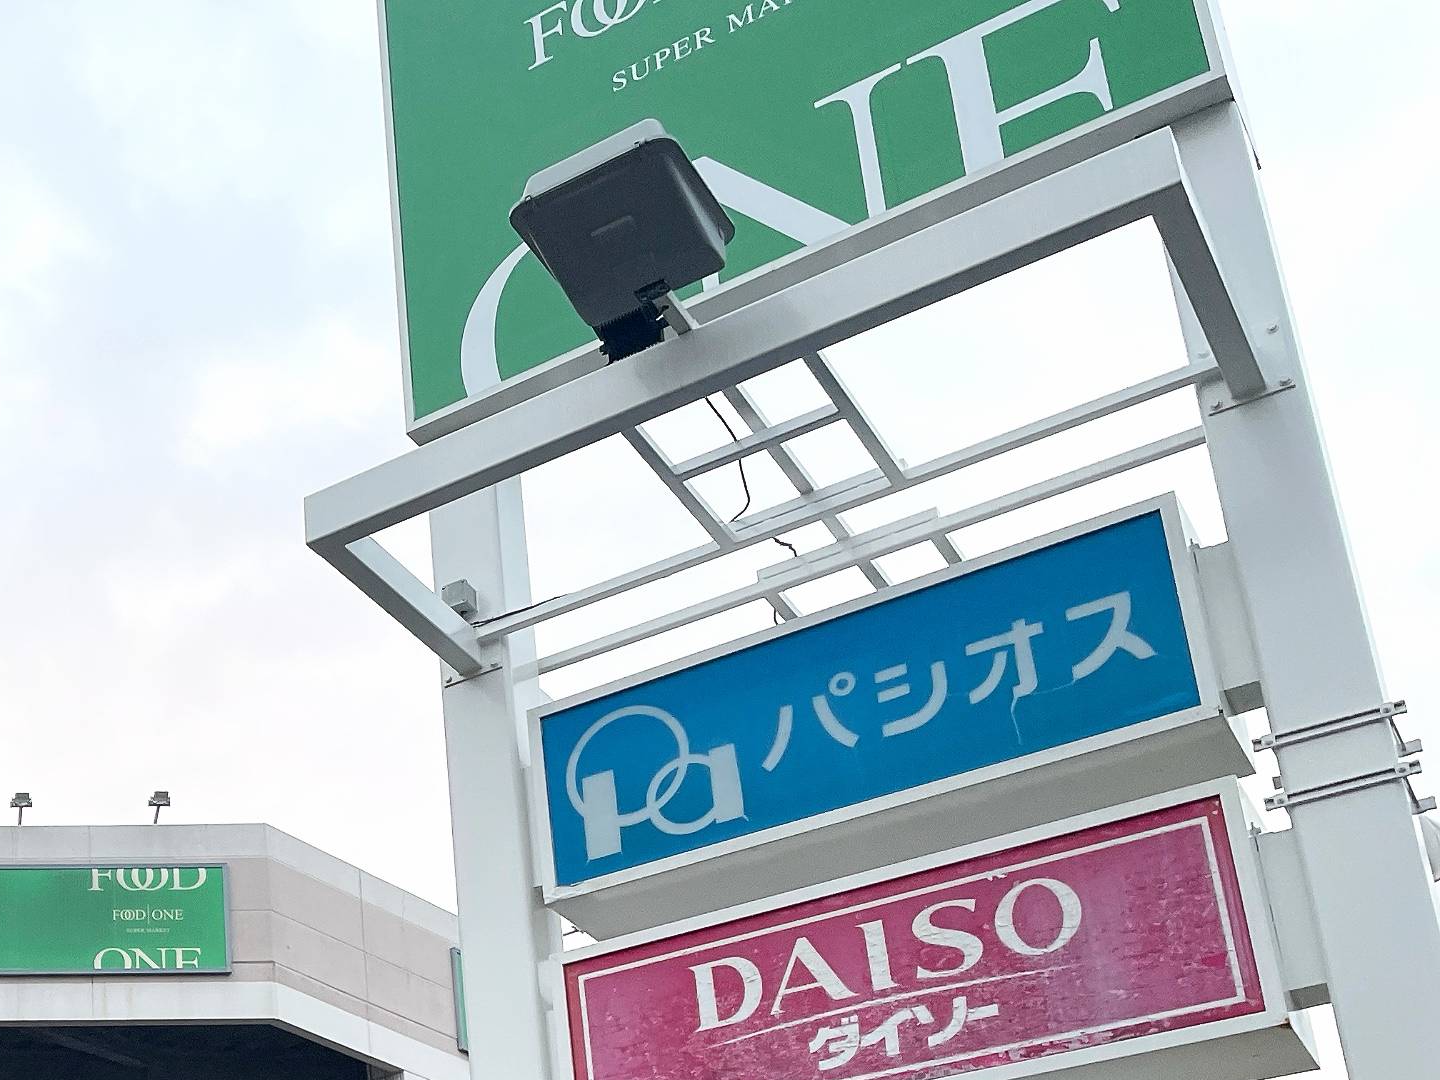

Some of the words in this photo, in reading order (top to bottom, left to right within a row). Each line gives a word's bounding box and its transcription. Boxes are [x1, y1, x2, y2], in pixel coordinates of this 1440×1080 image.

[611, 27, 716, 92] SUPER
[726, 0, 793, 34] MA
[761, 590, 1158, 772] パシオス
[688, 878, 1083, 1034] DAISO
[809, 996, 999, 1071] ダイソー
